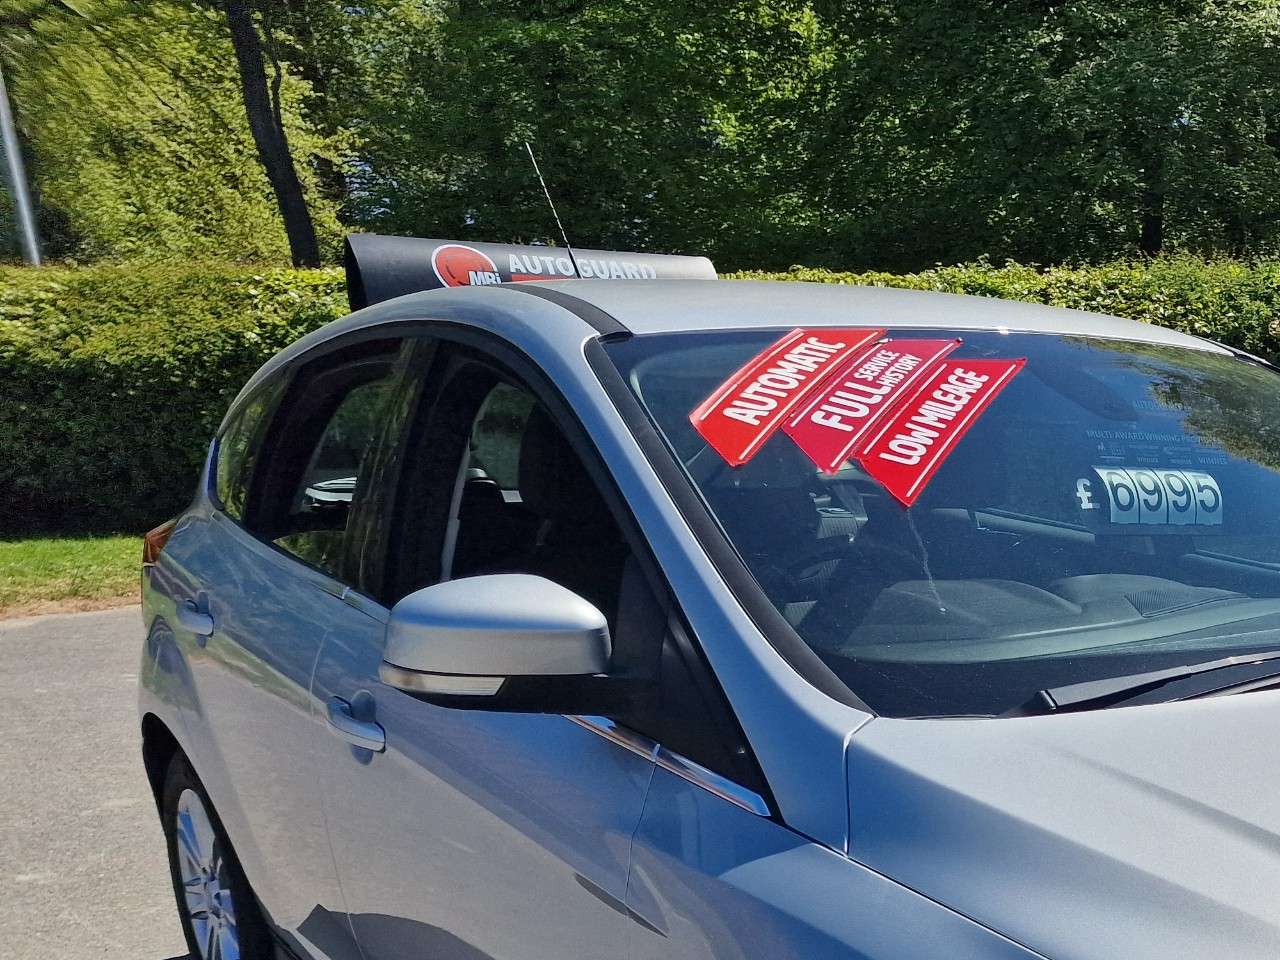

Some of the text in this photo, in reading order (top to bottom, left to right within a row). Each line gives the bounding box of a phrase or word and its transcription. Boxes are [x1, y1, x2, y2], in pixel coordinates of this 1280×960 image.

[722, 336, 846, 425] AUTOMATIC
[853, 349, 900, 380] SERVICE
[878, 353, 922, 388] HISTORY
[810, 382, 885, 431] FULL
[879, 368, 990, 466] LOW MILEAGE
[1105, 470, 1220, 513] 6995
